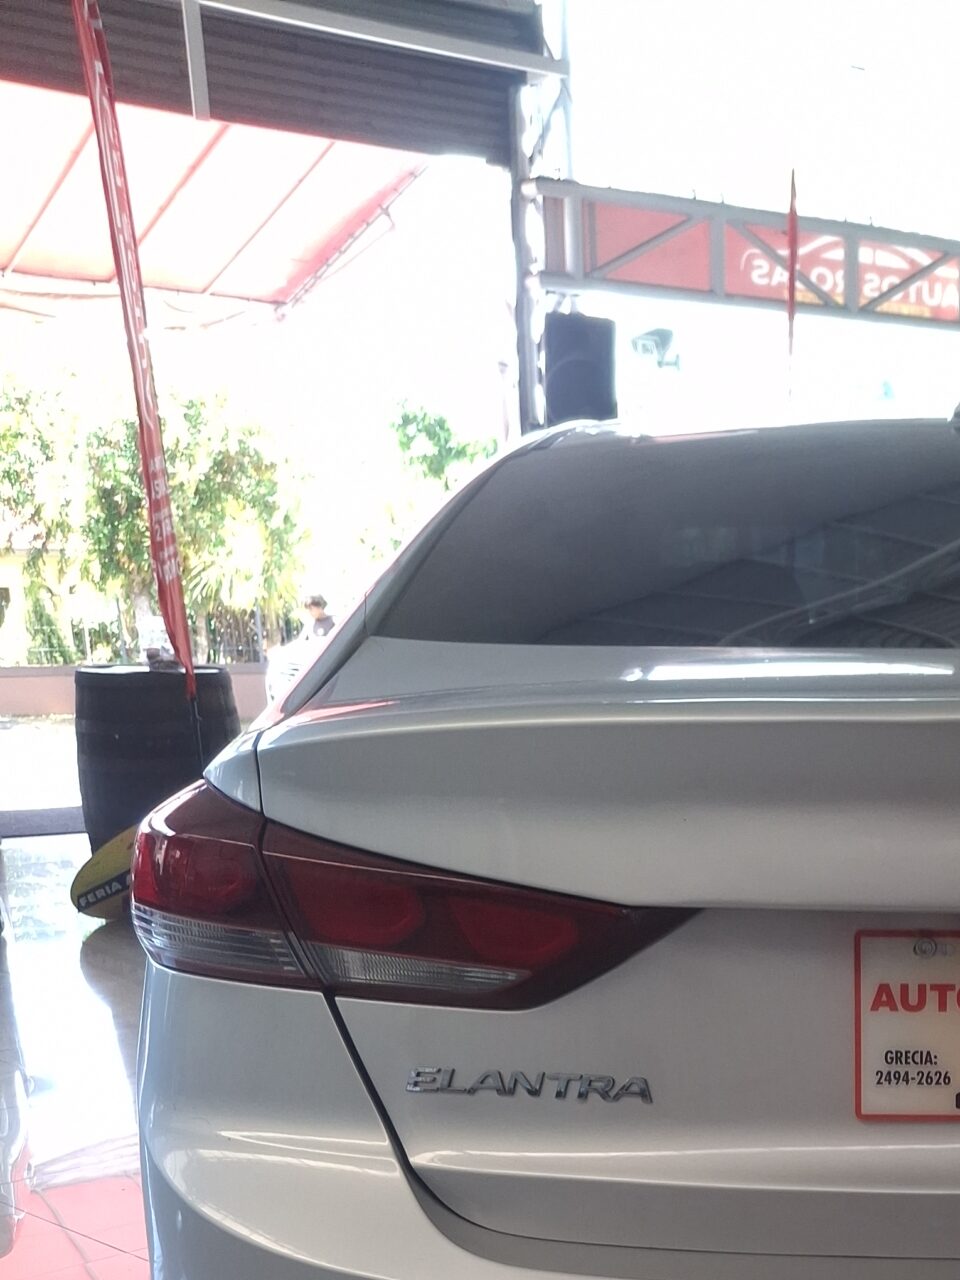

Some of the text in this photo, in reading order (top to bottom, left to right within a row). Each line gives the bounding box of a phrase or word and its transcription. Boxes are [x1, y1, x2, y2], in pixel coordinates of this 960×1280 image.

[79, 881, 122, 908] FERIA
[883, 1050, 939, 1067] GRECIA:
[404, 1066, 654, 1105] ELANTRA
[875, 1070, 952, 1087] 2494-2626
